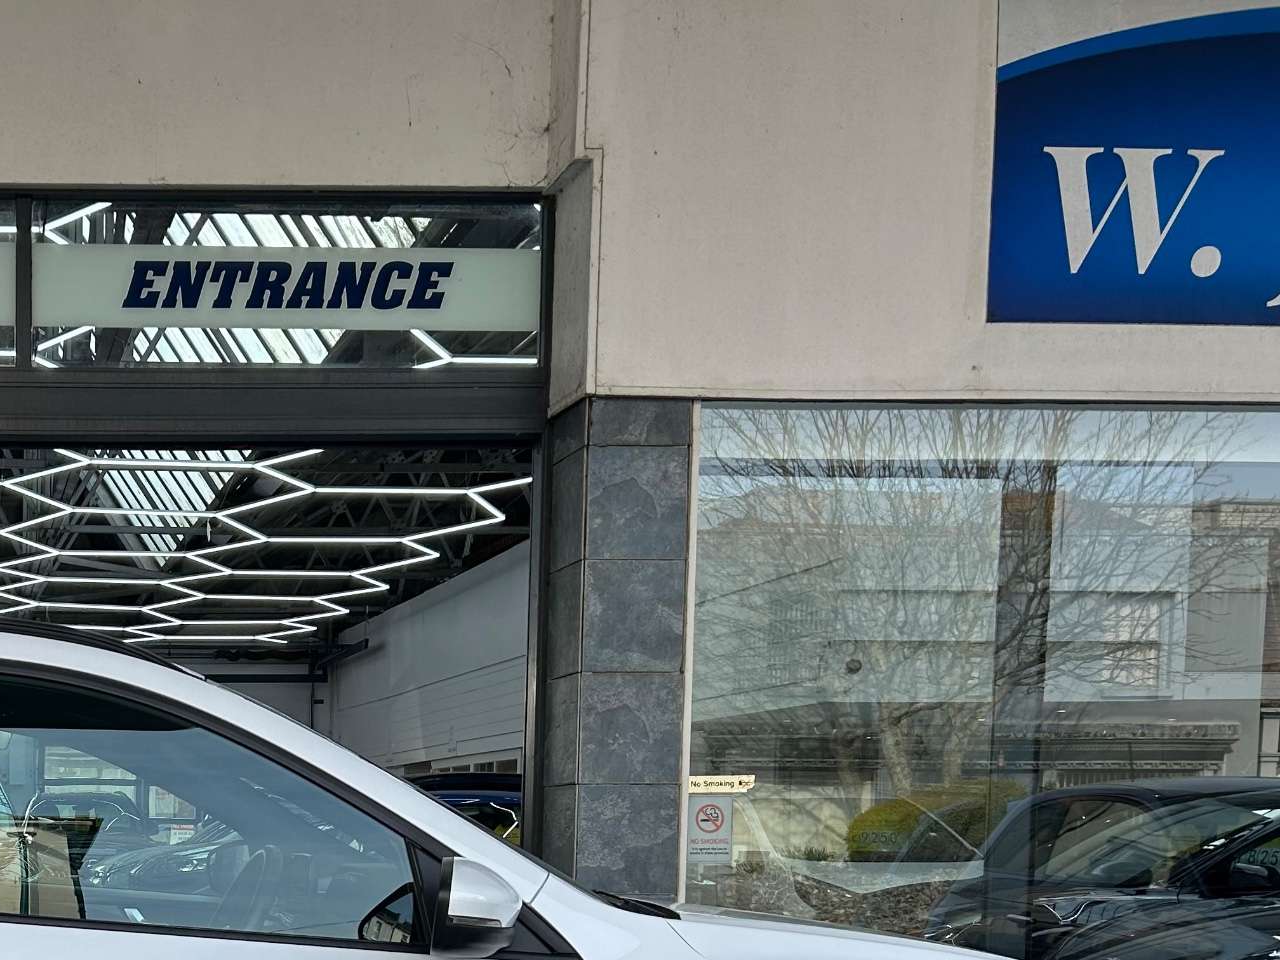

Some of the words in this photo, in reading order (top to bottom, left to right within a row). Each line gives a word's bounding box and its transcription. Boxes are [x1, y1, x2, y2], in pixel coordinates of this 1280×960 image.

[1043, 146, 1226, 278] W.
[121, 260, 455, 310] ENTRANCE
[690, 780, 701, 788] No
[703, 780, 735, 789] Smoking
